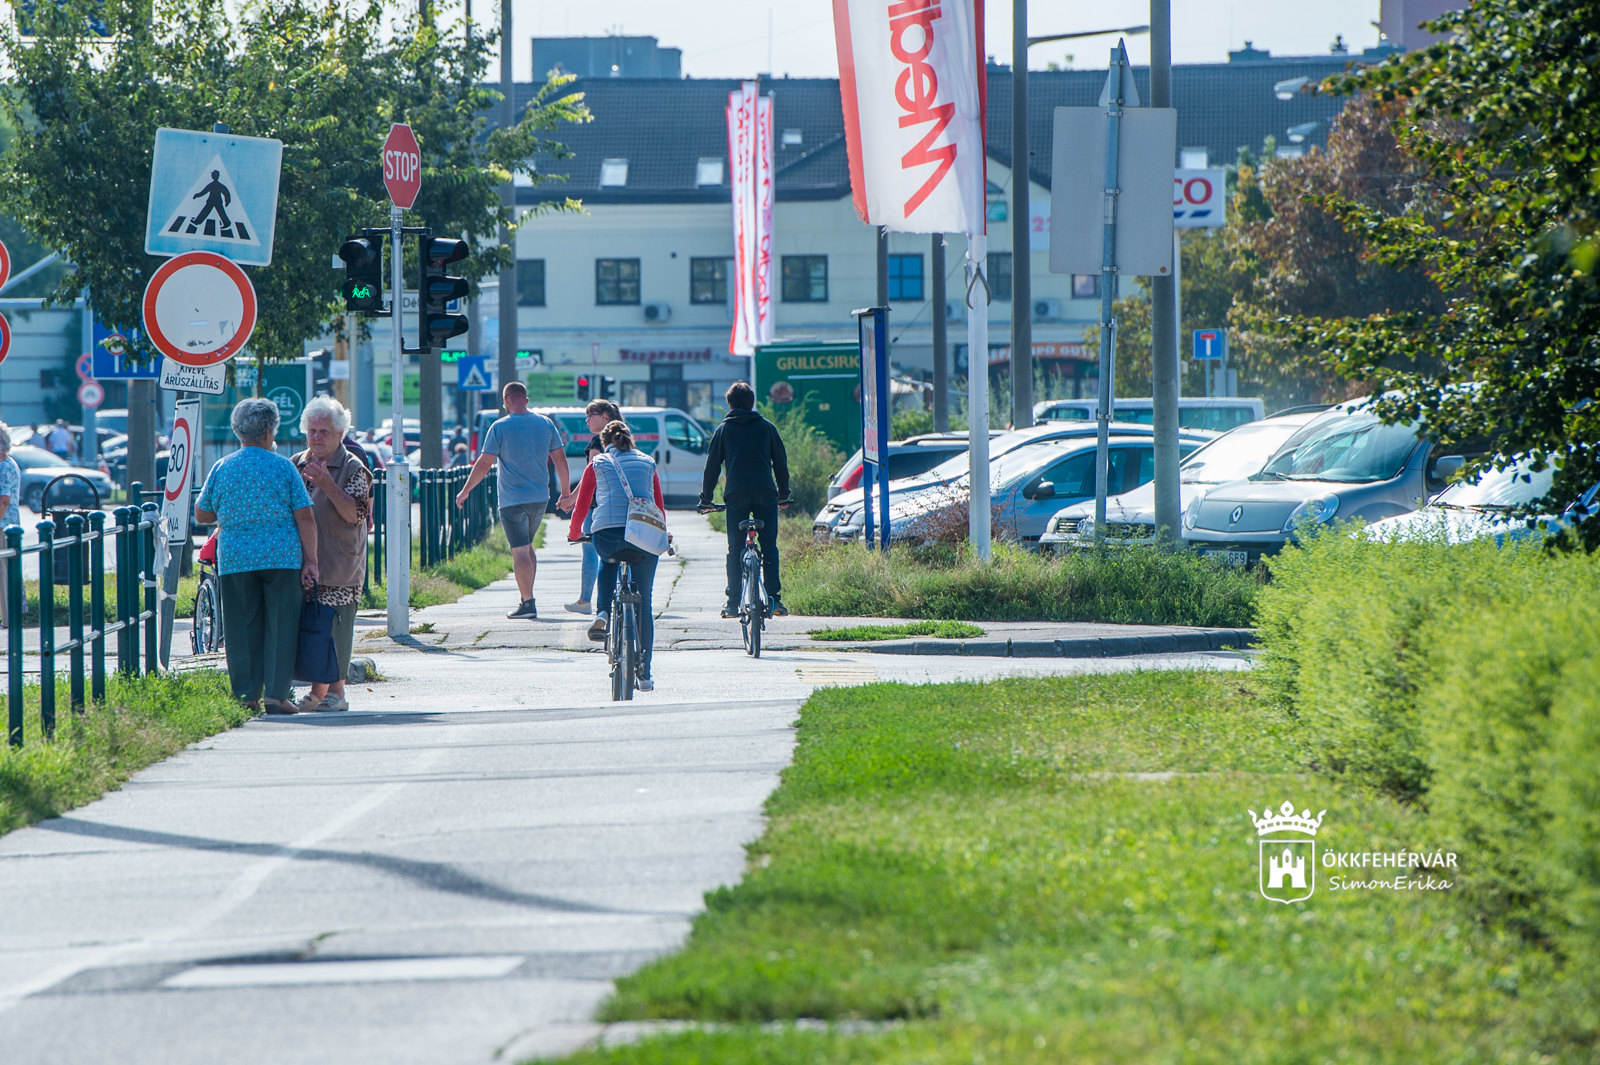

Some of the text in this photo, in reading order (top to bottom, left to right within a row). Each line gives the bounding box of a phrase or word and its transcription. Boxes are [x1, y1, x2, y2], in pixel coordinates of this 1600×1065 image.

[386, 150, 418, 182] STOP
[403, 297, 420, 308] Dé
[776, 354, 860, 371] GRILLCSIRK
[164, 372, 219, 390] ÁRUSZÁLLÍTÁS
[273, 392, 295, 408] FÉL
[168, 443, 185, 473] 30
